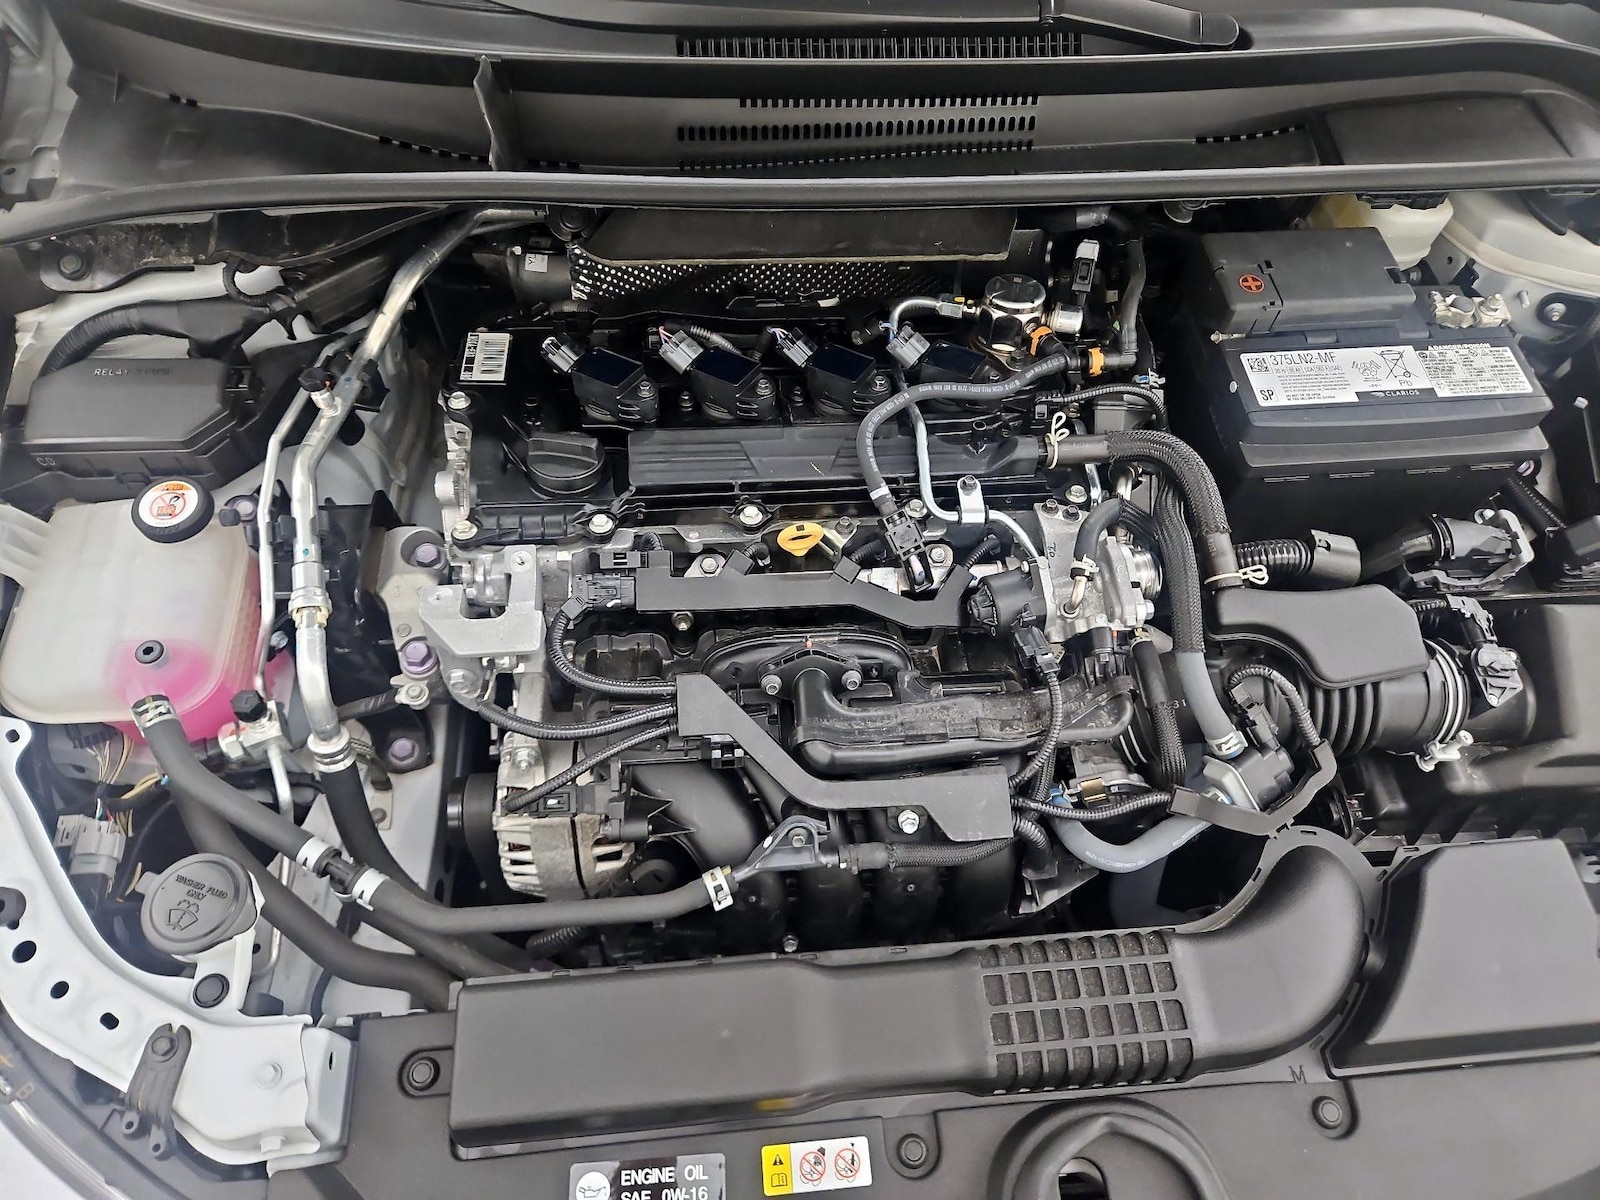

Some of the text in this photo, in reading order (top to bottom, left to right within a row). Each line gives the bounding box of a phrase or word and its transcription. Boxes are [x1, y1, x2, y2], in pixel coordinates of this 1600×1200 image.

[1269, 351, 1337, 366] 375LN2-MF
[94, 367, 130, 377] RELAY
[1260, 389, 1274, 401] SP
[1386, 389, 1420, 397] CLARIOS
[176, 874, 206, 890] WASHER
[187, 889, 207, 901] ONLY
[620, 1164, 709, 1187] ENGINE OIL
[620, 1186, 709, 1200] SAE 0W-16
